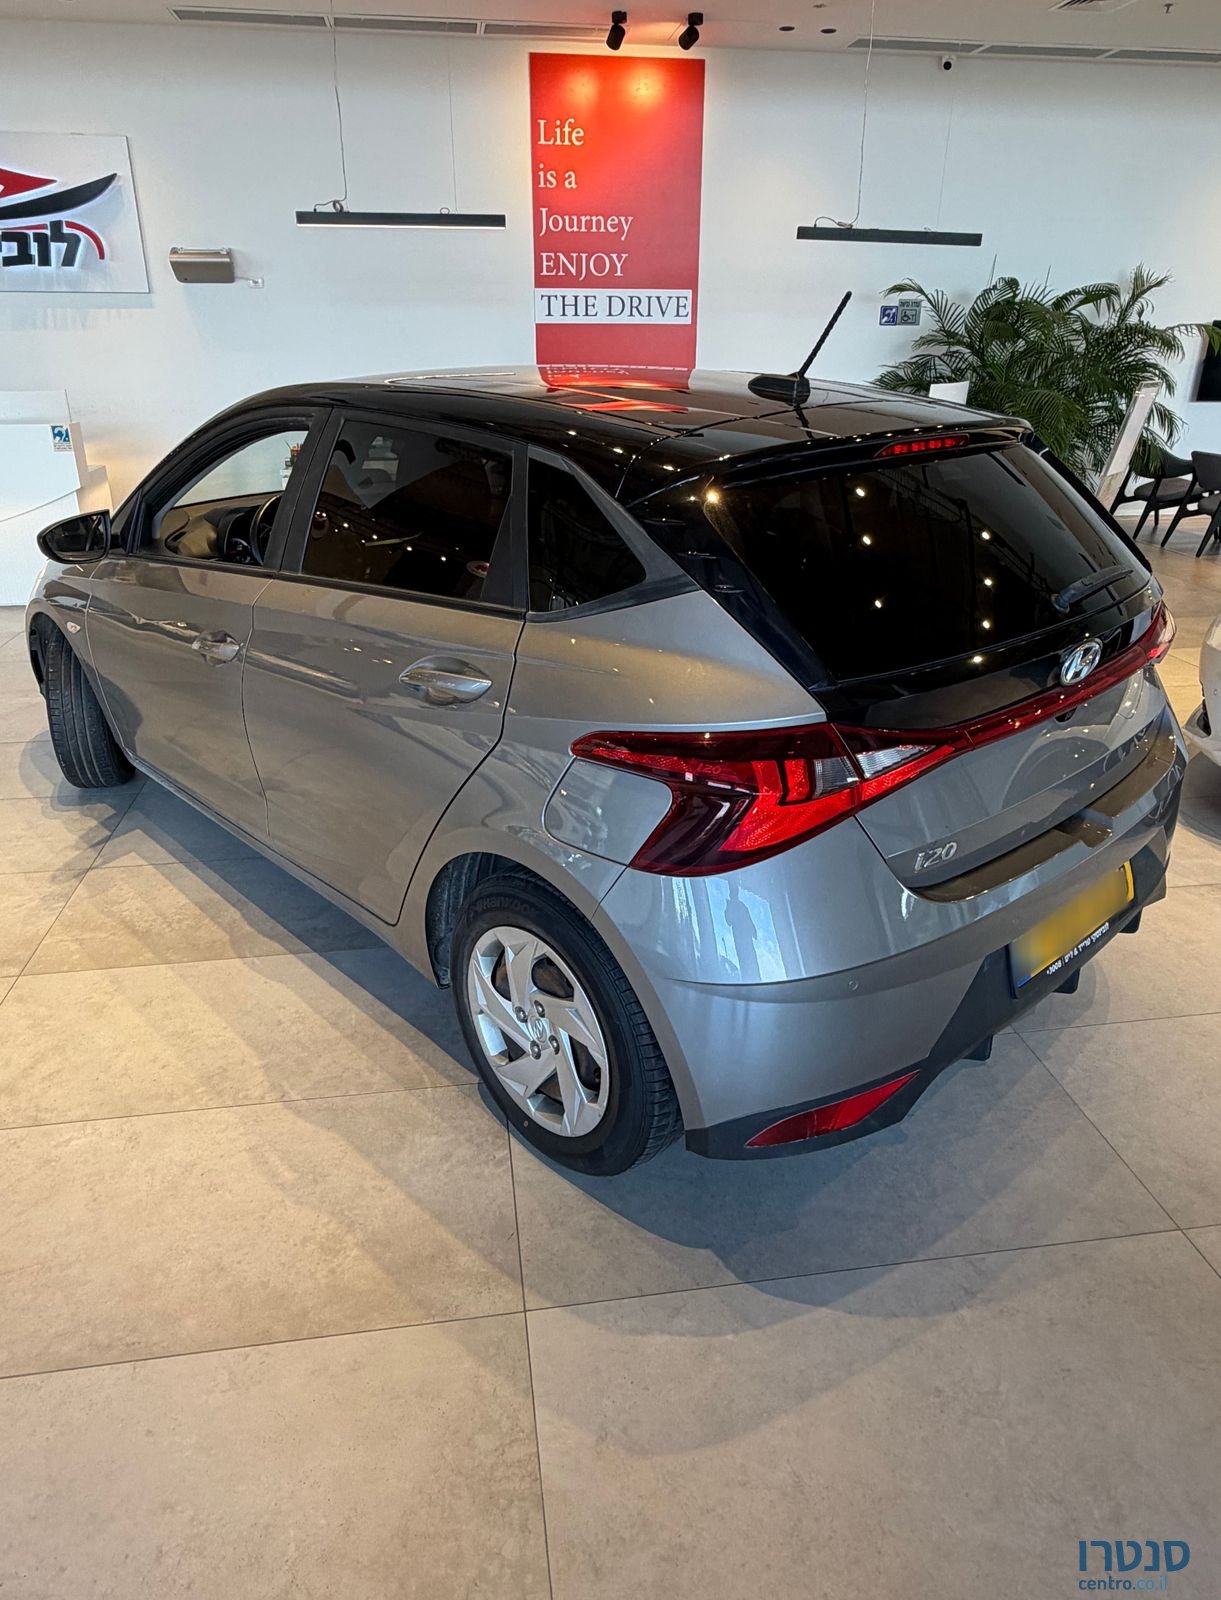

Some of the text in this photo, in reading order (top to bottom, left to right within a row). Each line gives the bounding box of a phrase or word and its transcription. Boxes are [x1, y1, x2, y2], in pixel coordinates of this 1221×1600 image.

[537, 118, 585, 146] Life
[537, 164, 578, 189] is a
[539, 208, 634, 240] Journey
[0, 220, 81, 267] לוב
[540, 253, 628, 281] ENJOY
[541, 294, 690, 318] THE DRIVE
[914, 841, 958, 873] i20
